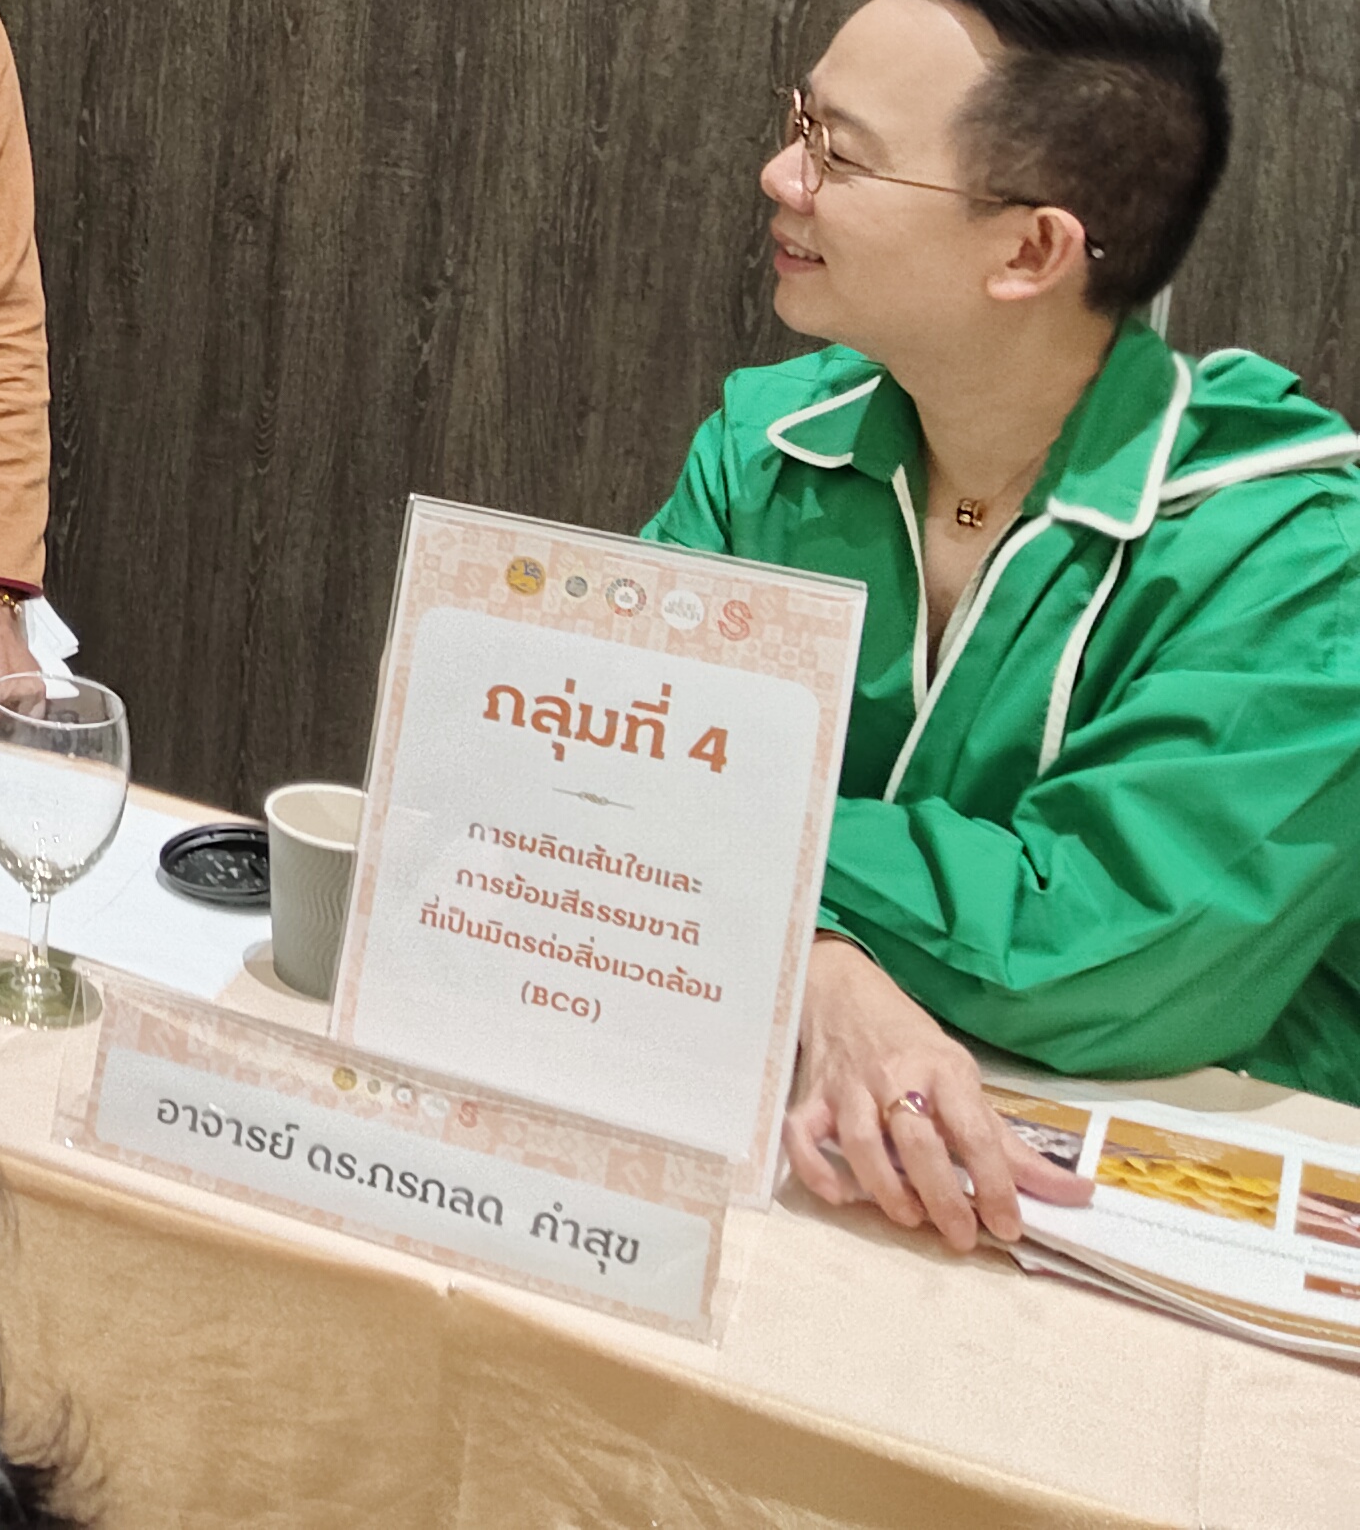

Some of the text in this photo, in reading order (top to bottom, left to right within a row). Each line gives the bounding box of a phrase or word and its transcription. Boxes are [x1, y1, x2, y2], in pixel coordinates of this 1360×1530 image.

[483, 677, 729, 774] กลุ่มที่ 4
[468, 821, 703, 894] การผลิตเส้นใยและ
[419, 894, 723, 1003] ที่เป็นมิตรต่อสิ่งแวดล้อม
[455, 868, 701, 946] การย้อมสีธรรมชาติ
[521, 980, 602, 1023] (BCG)
[156, 1098, 640, 1275] อาจารย์ ดร.กรกลด คำสุข
